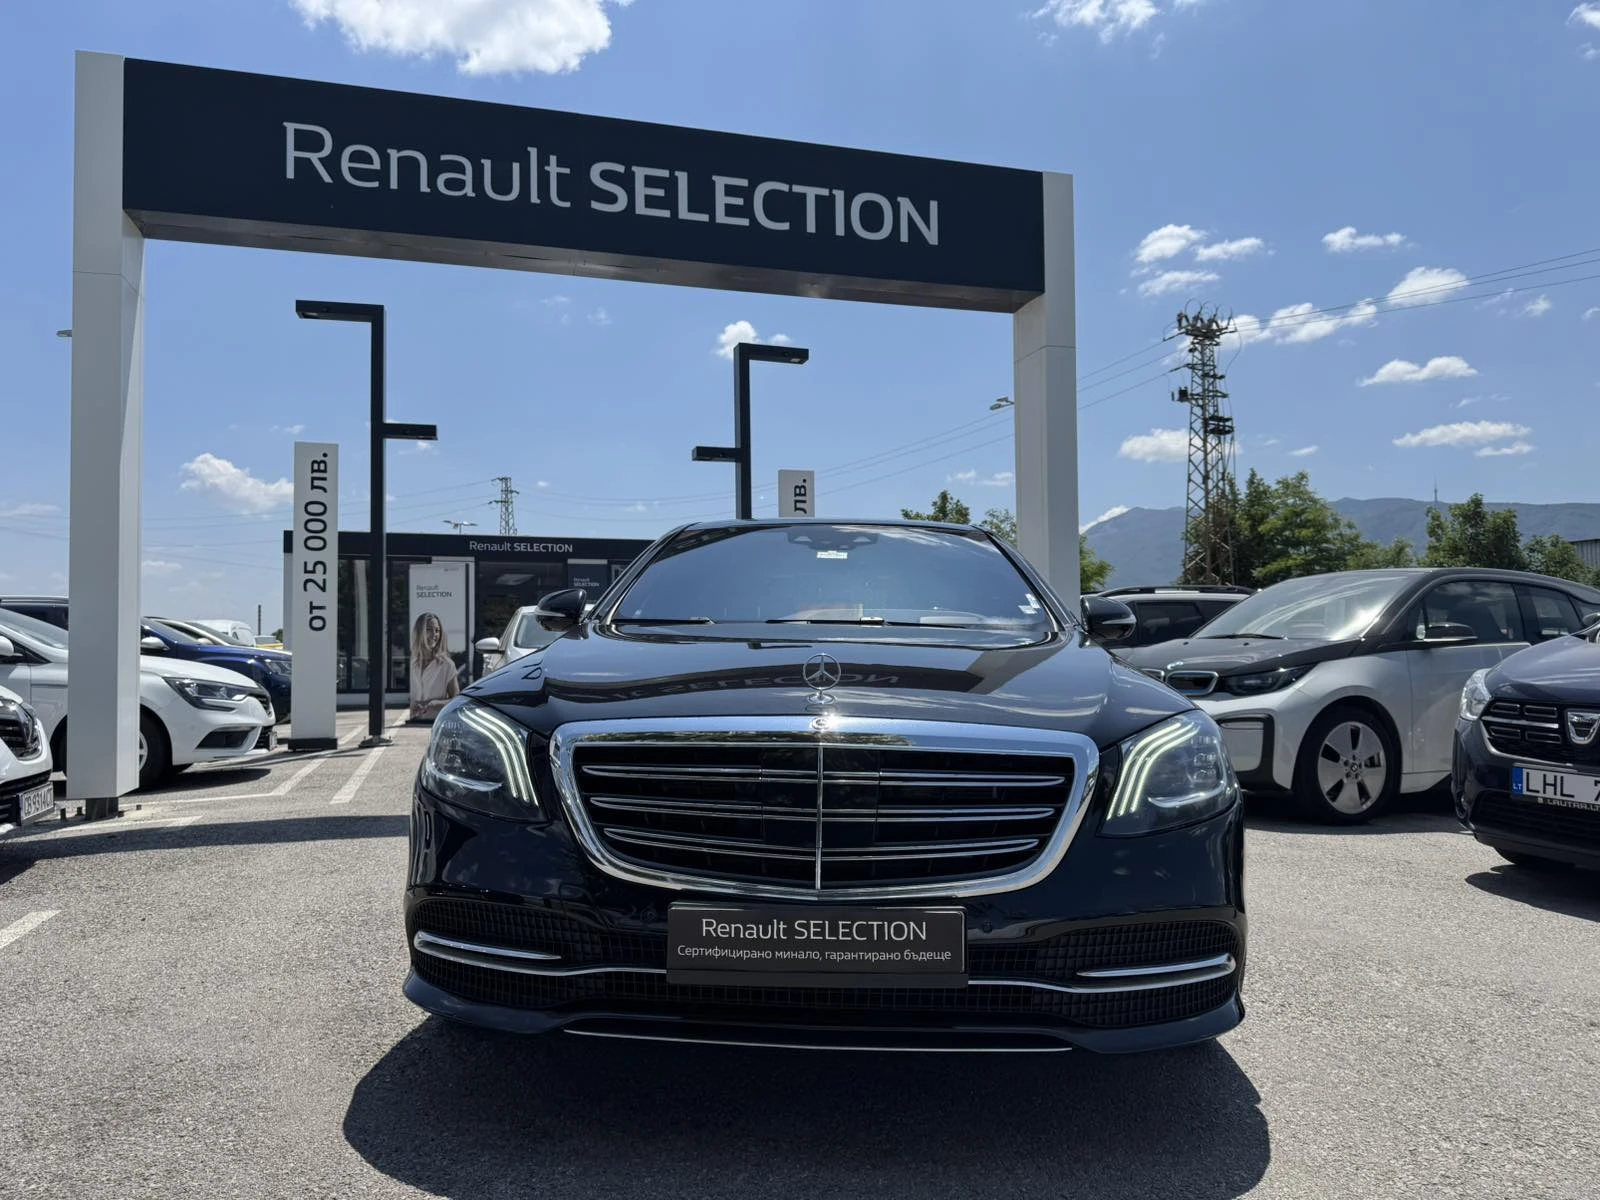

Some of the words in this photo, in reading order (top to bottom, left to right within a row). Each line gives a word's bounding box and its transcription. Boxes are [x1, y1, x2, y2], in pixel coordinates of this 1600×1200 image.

[283, 121, 572, 208] Renault
[589, 161, 940, 247] SELECTION
[310, 452, 328, 494] лв.
[793, 478, 808, 515] лв.
[303, 500, 328, 552] 000
[469, 540, 512, 552] Renault
[513, 543, 574, 553] SELECTION
[303, 560, 327, 593] 25
[416, 591, 453, 599] SELECTION
[308, 600, 327, 632] от
[1525, 771, 1576, 798] LHL
[701, 918, 788, 940] Renault
[794, 919, 928, 942] SELECTION
[677, 944, 773, 960] Сертифицирано
[774, 948, 823, 961] минало,
[825, 950, 902, 962] гарантирано
[903, 948, 952, 961] бъдеще
